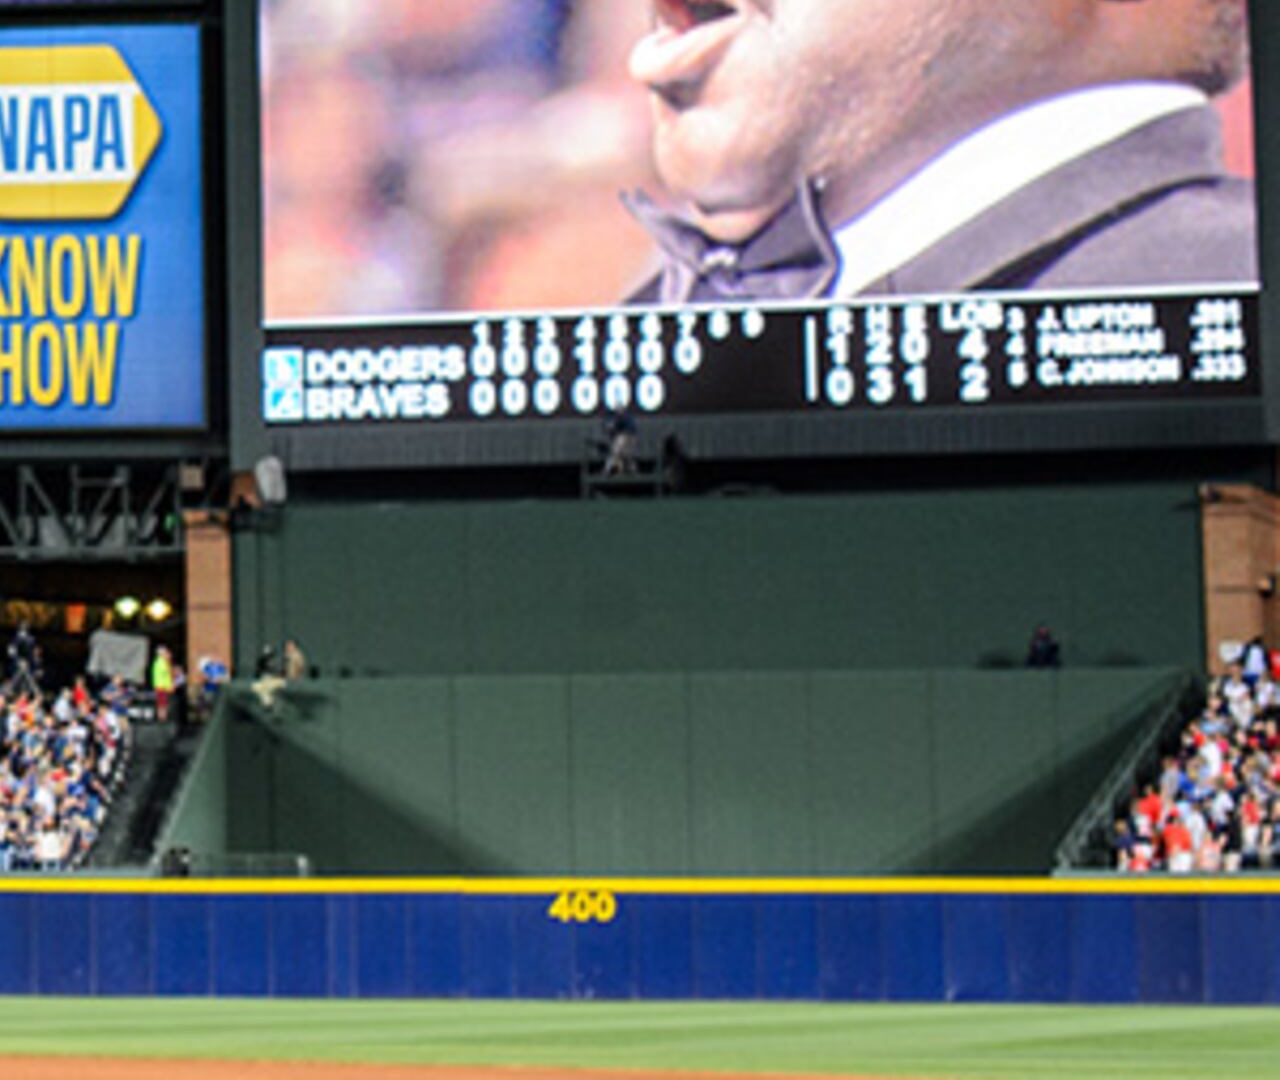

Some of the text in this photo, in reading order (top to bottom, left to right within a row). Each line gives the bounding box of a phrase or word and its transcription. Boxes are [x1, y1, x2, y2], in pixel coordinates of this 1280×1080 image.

[1063, 303, 1155, 329] UPTON
[306, 329, 989, 383] DODGERS 0 0 0 1 0 0 0 1 2 0 4
[1037, 328, 1165, 357] FREEMAN
[1065, 354, 1181, 386] JOHNSON
[306, 361, 990, 418] BRAVES 0 0 0 0 0 0 0 3 1 2
[548, 891, 617, 922] 400
